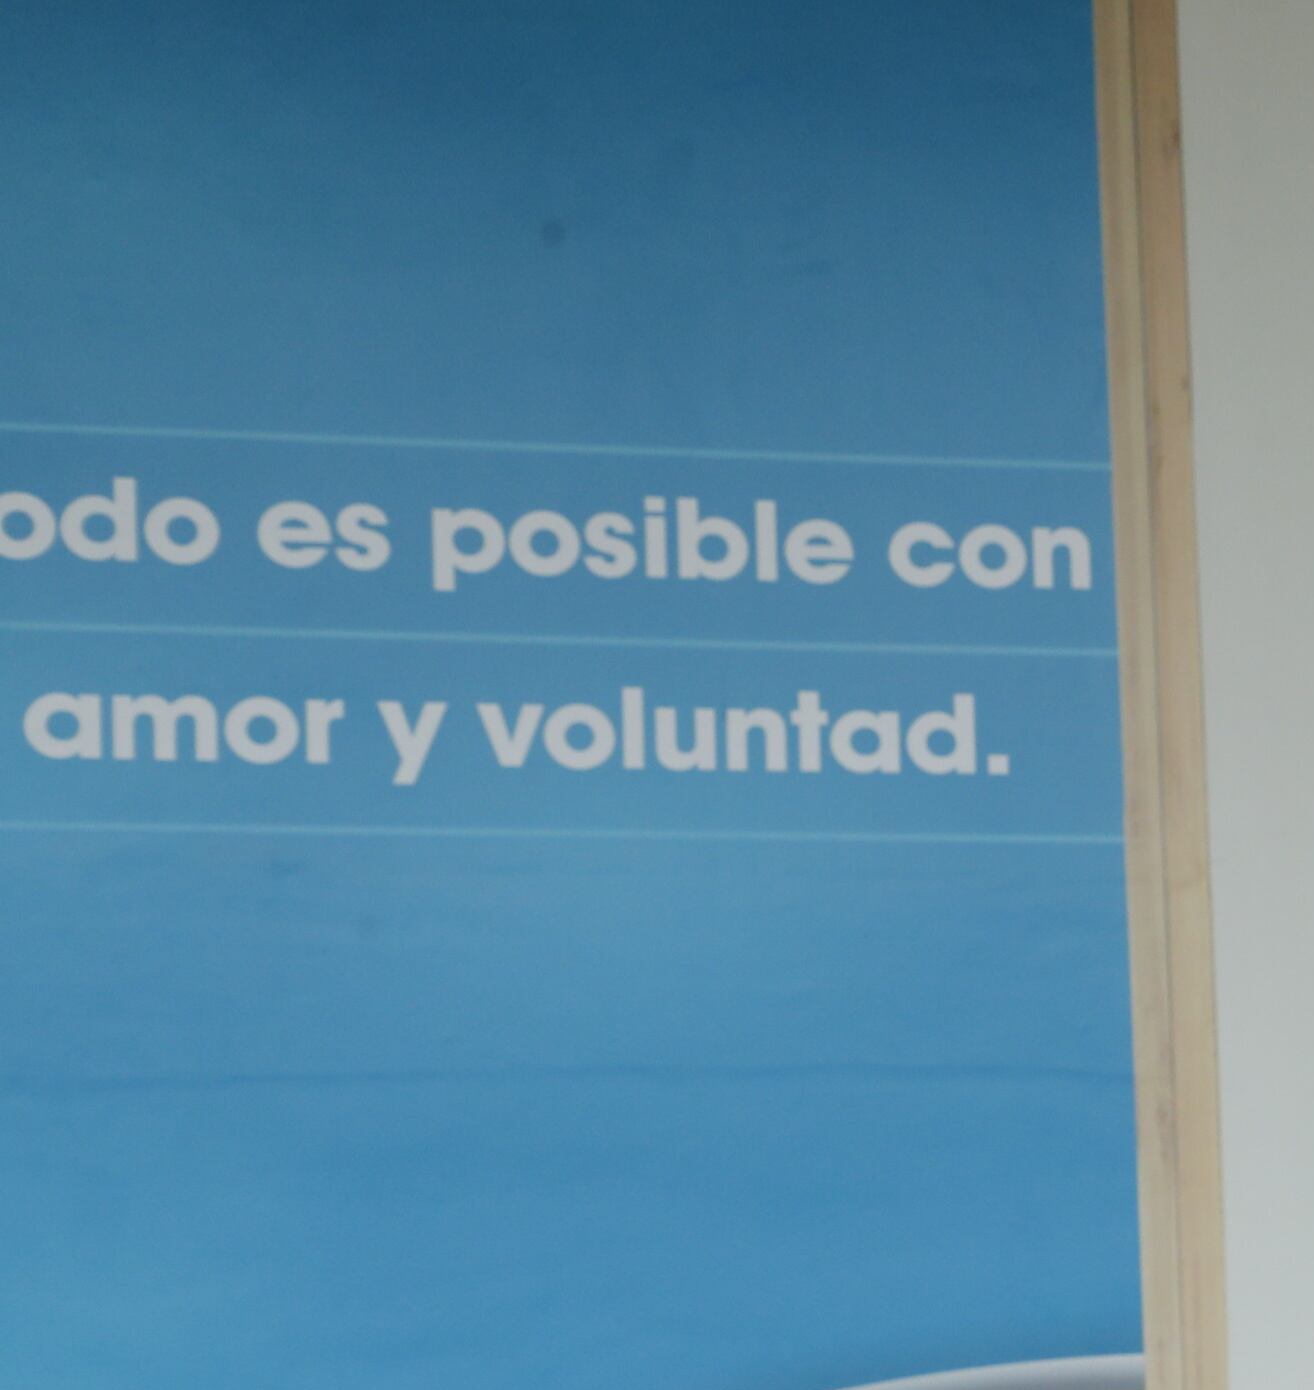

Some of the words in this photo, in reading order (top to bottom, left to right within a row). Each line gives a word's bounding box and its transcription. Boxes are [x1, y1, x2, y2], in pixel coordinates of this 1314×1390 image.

[0, 476, 220, 566] odo
[257, 498, 392, 572] es
[431, 495, 854, 592] posible
[888, 520, 1093, 590] con
[22, 689, 346, 765] amor
[377, 699, 447, 785] y
[476, 685, 1010, 776] voluntad.
